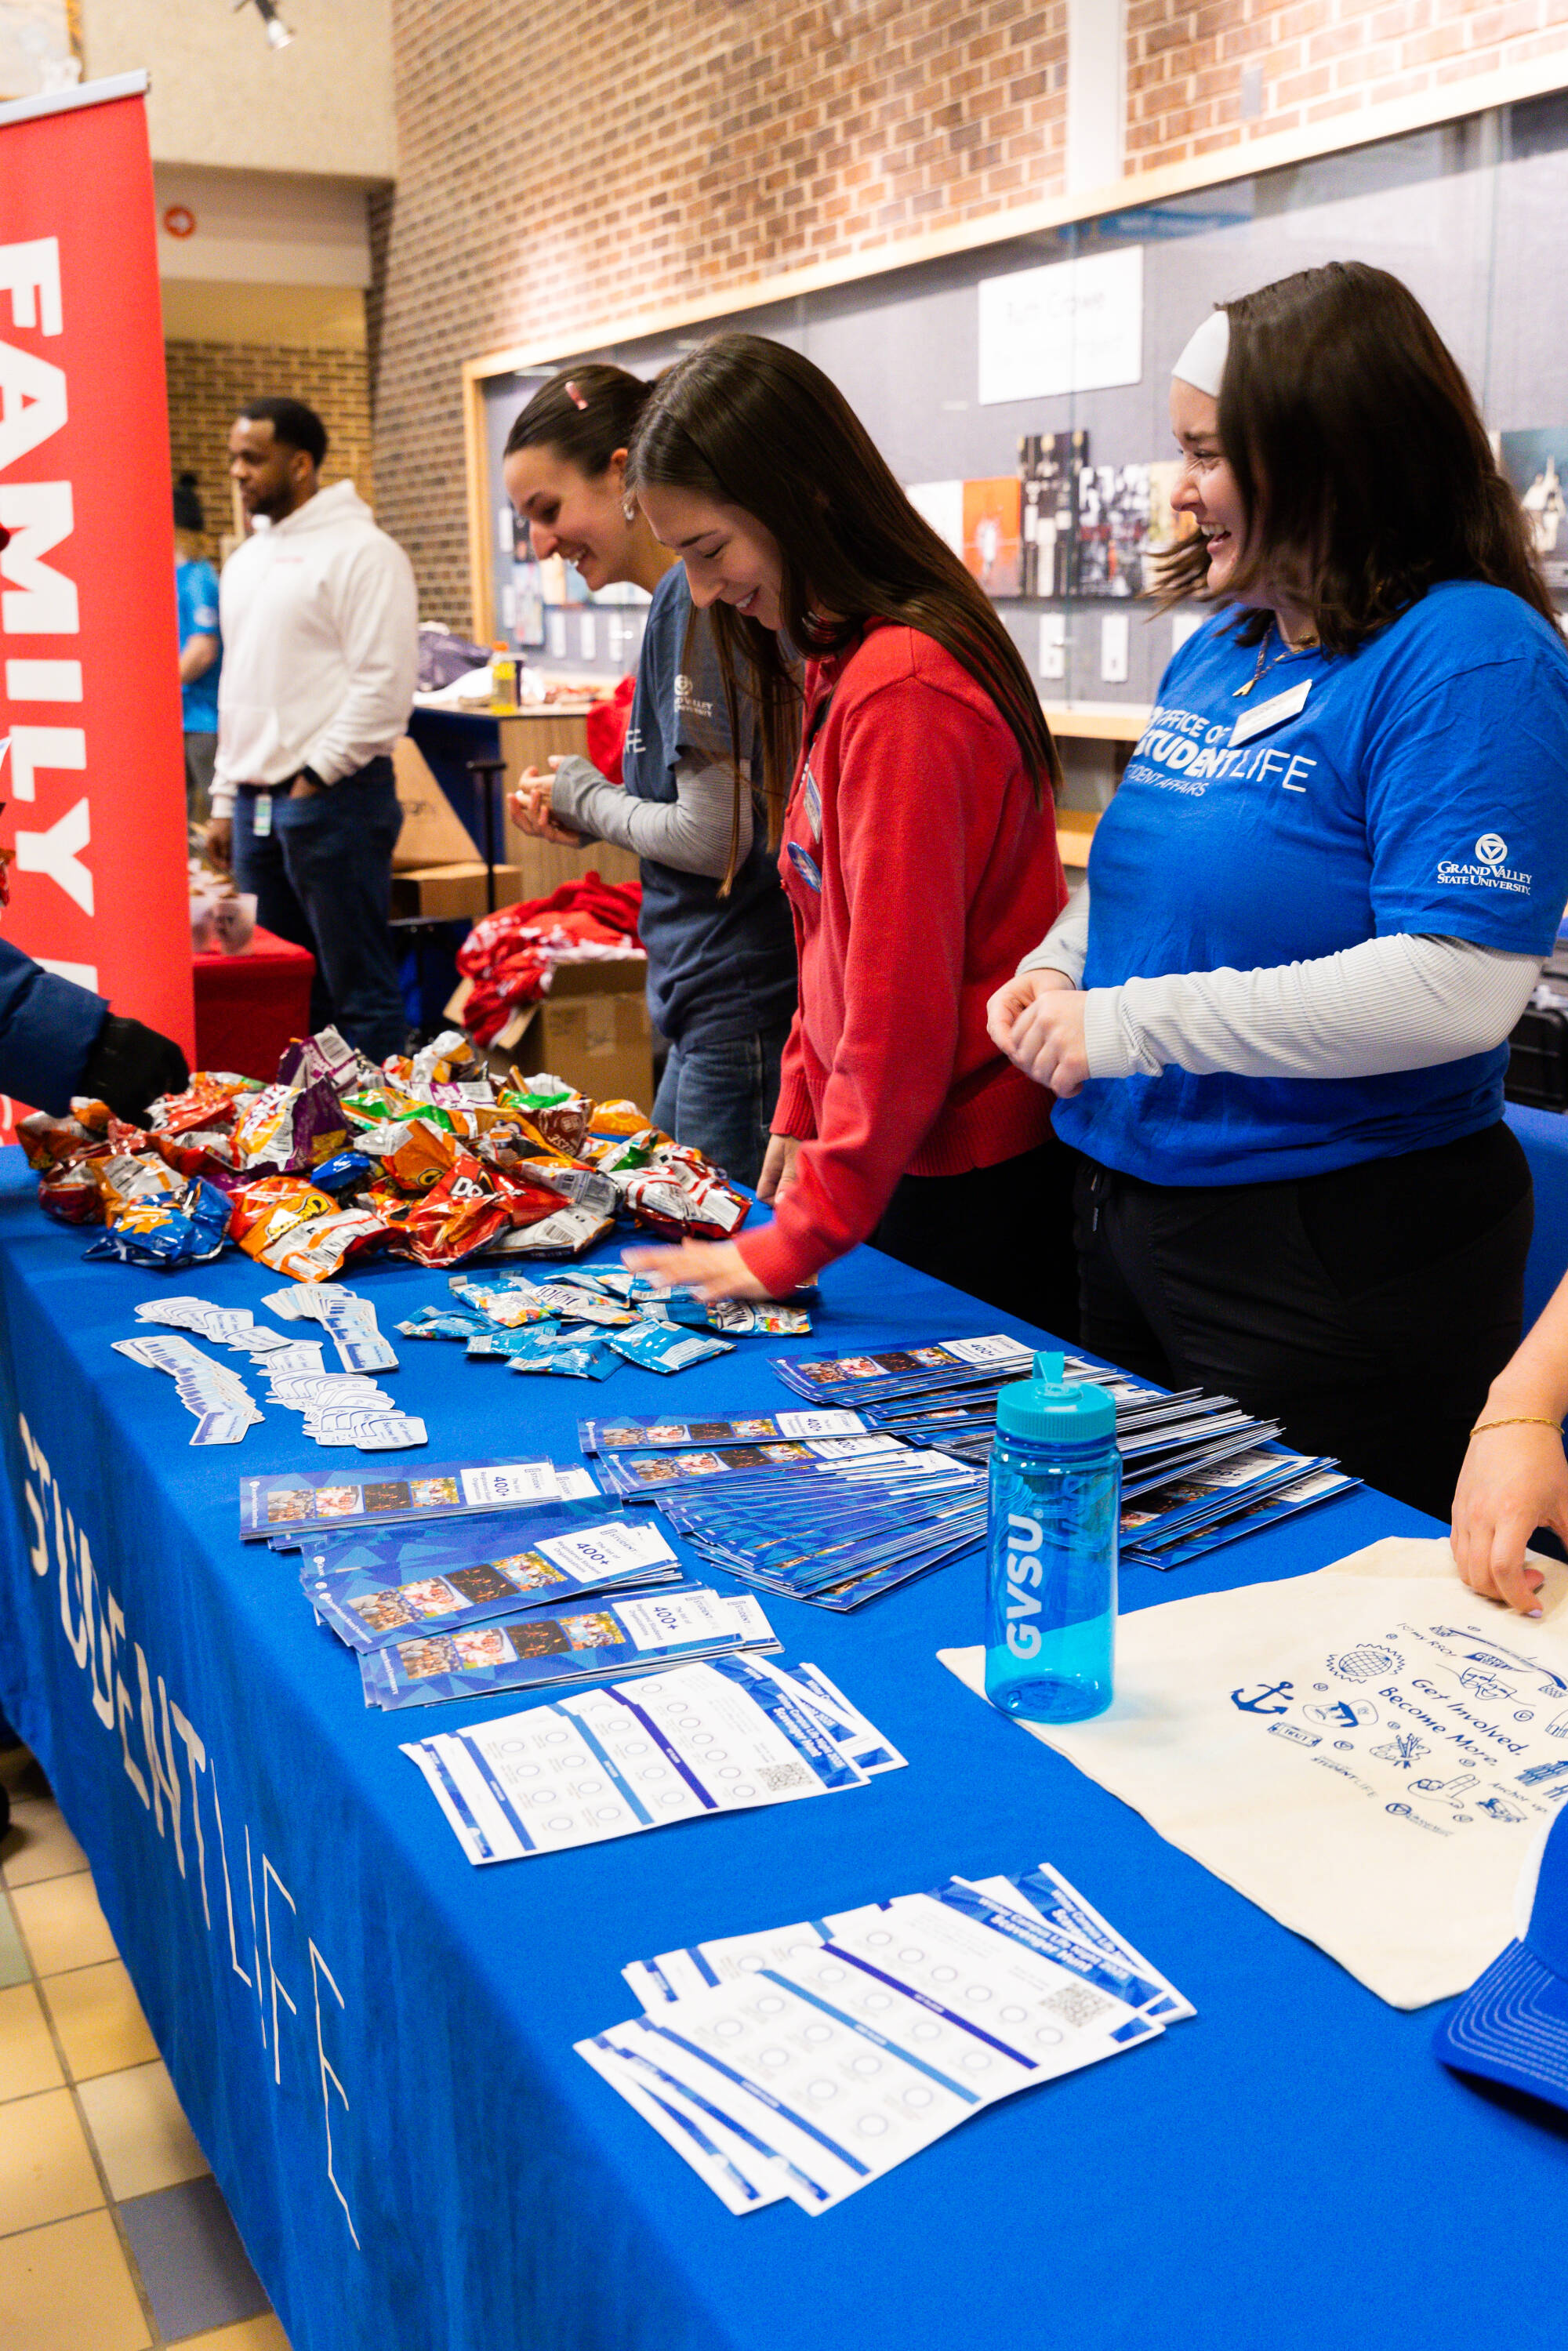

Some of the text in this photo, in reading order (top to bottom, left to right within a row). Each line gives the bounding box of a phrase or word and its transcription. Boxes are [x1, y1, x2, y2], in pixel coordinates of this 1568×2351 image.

[0, 236, 94, 917] FAMILY
[1154, 778, 1209, 796] AFFAIRS
[1437, 861, 1532, 884] GRAND VALLEY
[1437, 873, 1468, 884] STATE
[971, 1344, 995, 1356] 400+
[806, 1418, 822, 1431] 400+
[494, 1476, 510, 1496] 400+
[576, 1543, 610, 1565] 400+
[1007, 1513, 1044, 1660] GVSU
[653, 1607, 678, 1630] 400+
[773, 1706, 806, 1741] Scavenger
[801, 1739, 822, 1758] Hunt
[775, 1693, 793, 1709] Winter
[789, 1709, 810, 1729] Campus
[807, 1727, 820, 1740] Life
[816, 1737, 833, 1754] Night
[1378, 1687, 1498, 1766] Become More.
[1412, 1679, 1530, 1755] Get Involved.
[978, 1896, 1012, 1917] Winter
[1010, 1912, 1053, 1939] Campus
[1051, 1934, 1073, 1950] Life
[1070, 1944, 1103, 1966] Night
[1073, 1910, 1104, 1941] Campus
[990, 1914, 1094, 1972] Scavenger Hunt
